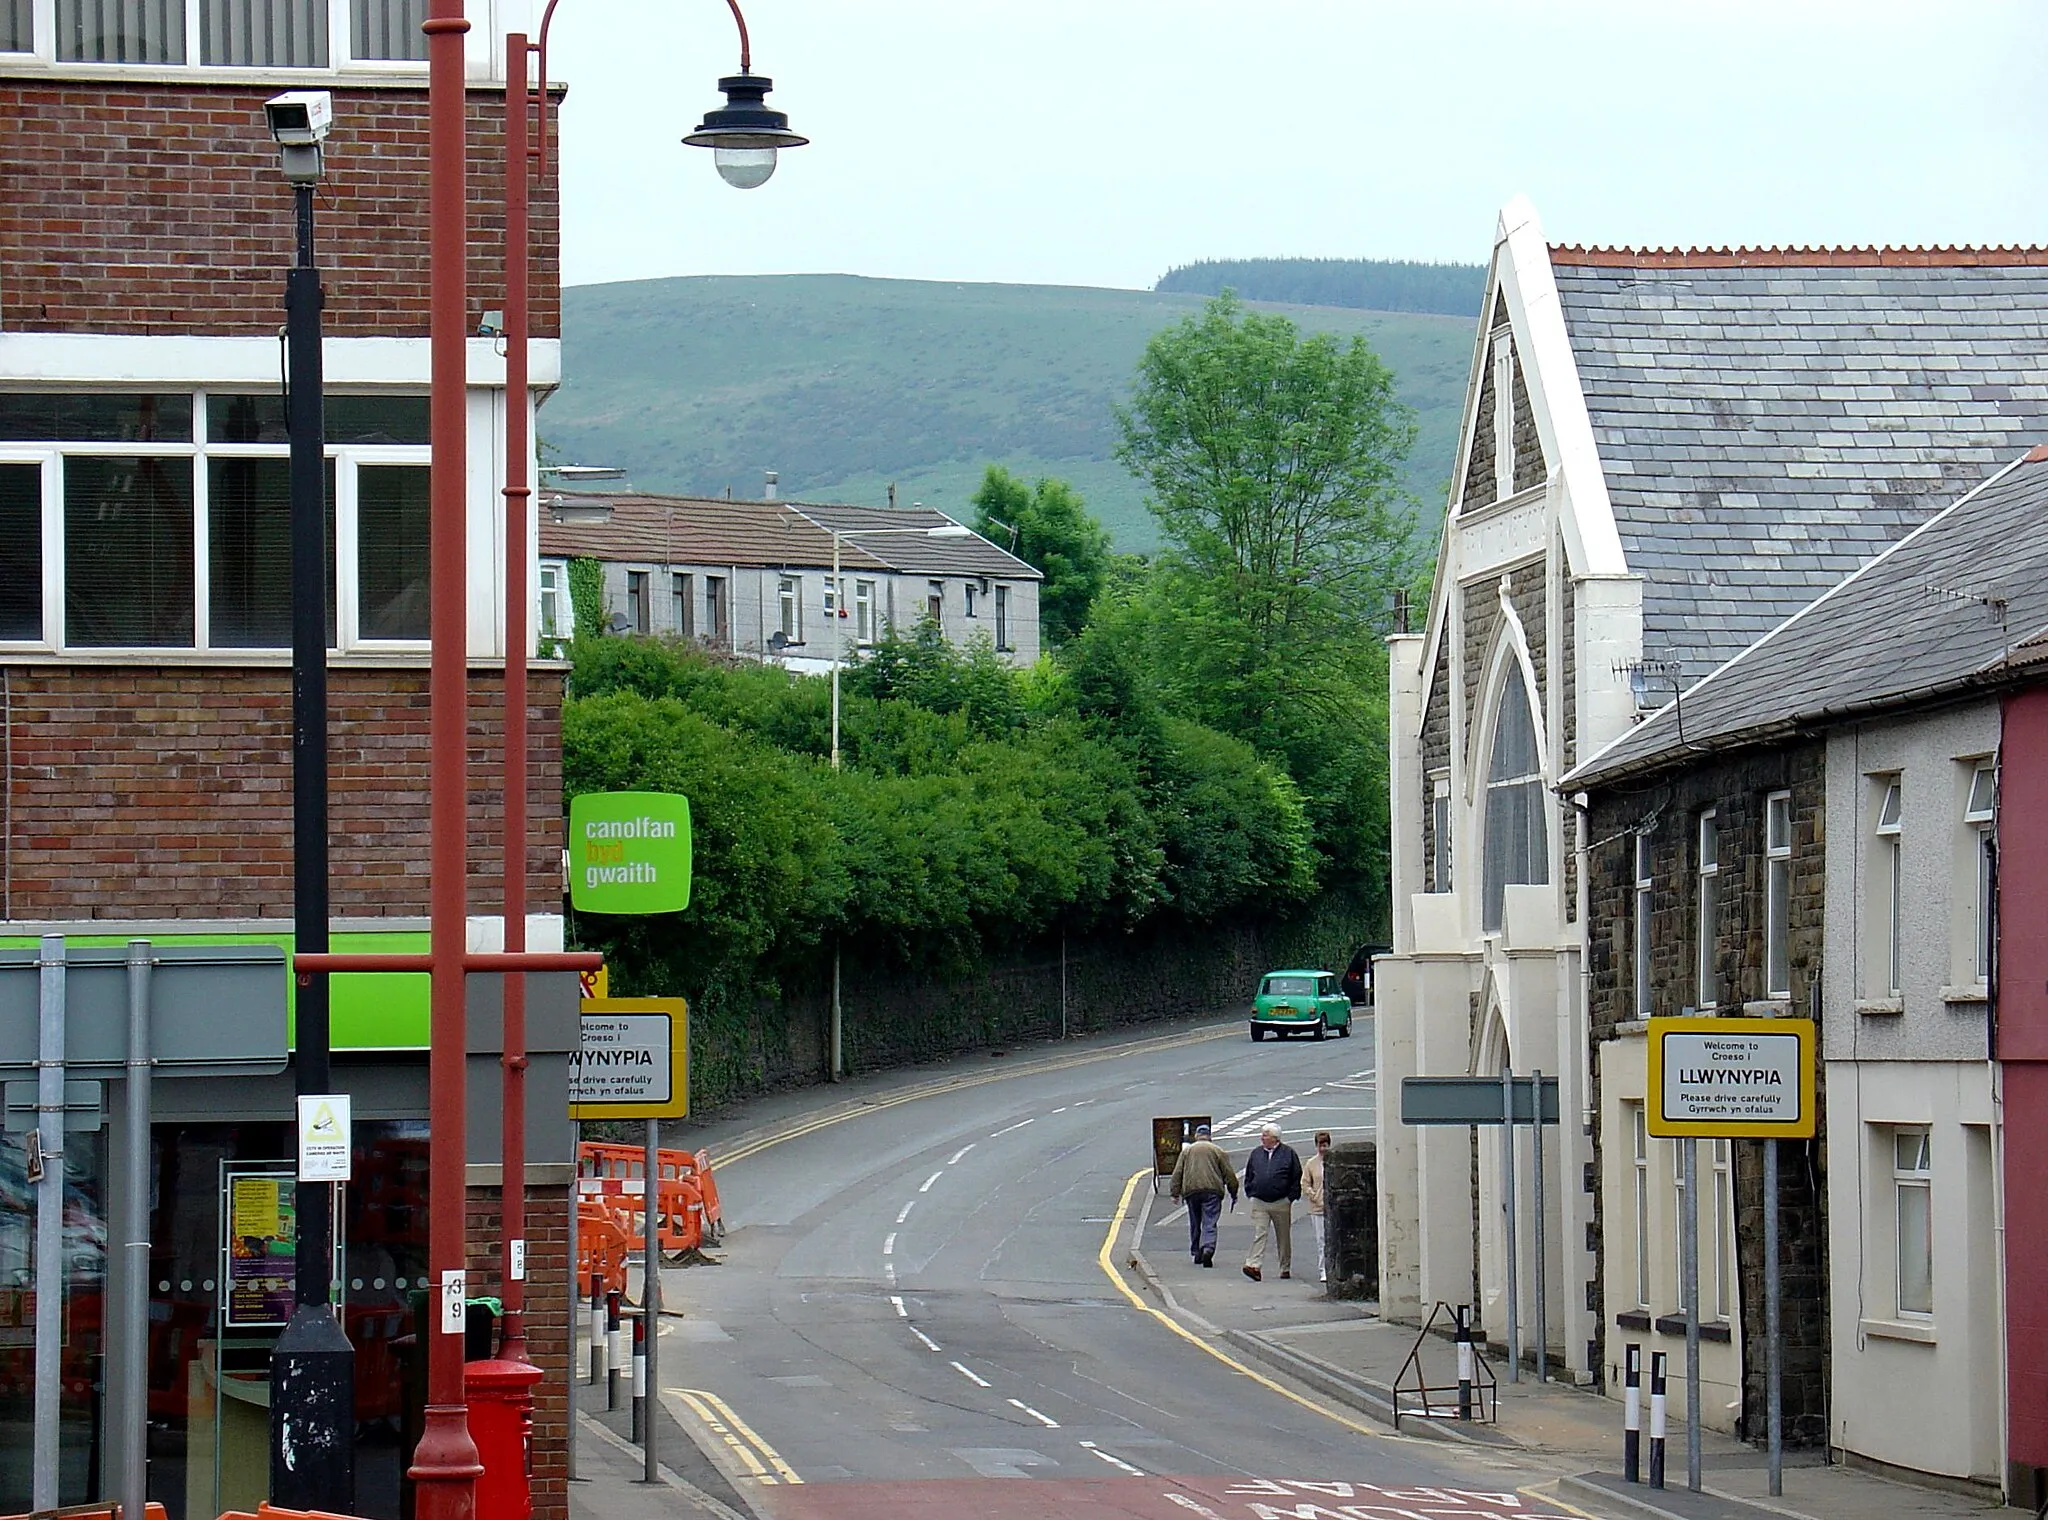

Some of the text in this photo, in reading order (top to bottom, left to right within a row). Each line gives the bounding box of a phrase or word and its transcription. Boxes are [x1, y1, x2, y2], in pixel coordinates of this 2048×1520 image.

[586, 816, 675, 838] canolfan
[586, 840, 623, 865] byd
[586, 862, 657, 889] gwaith
[581, 1022, 629, 1031] elcome to
[581, 1033, 614, 1042] Croeso
[1703, 1041, 1759, 1050] Welcome to
[569, 1050, 653, 1067] WYNYPIA
[1711, 1052, 1744, 1061] Croeso
[582, 1075, 606, 1084] drive
[610, 1075, 653, 1086] carefully
[1679, 1068, 1782, 1085] LLWYNYPIA
[568, 1086, 645, 1096] rrwch yn ofalus
[1680, 1093, 1782, 1105] Please drive carefully
[1688, 1104, 1774, 1115] Gyrrwch yn ofalus
[1225, 1479, 1522, 1508] ARAF
